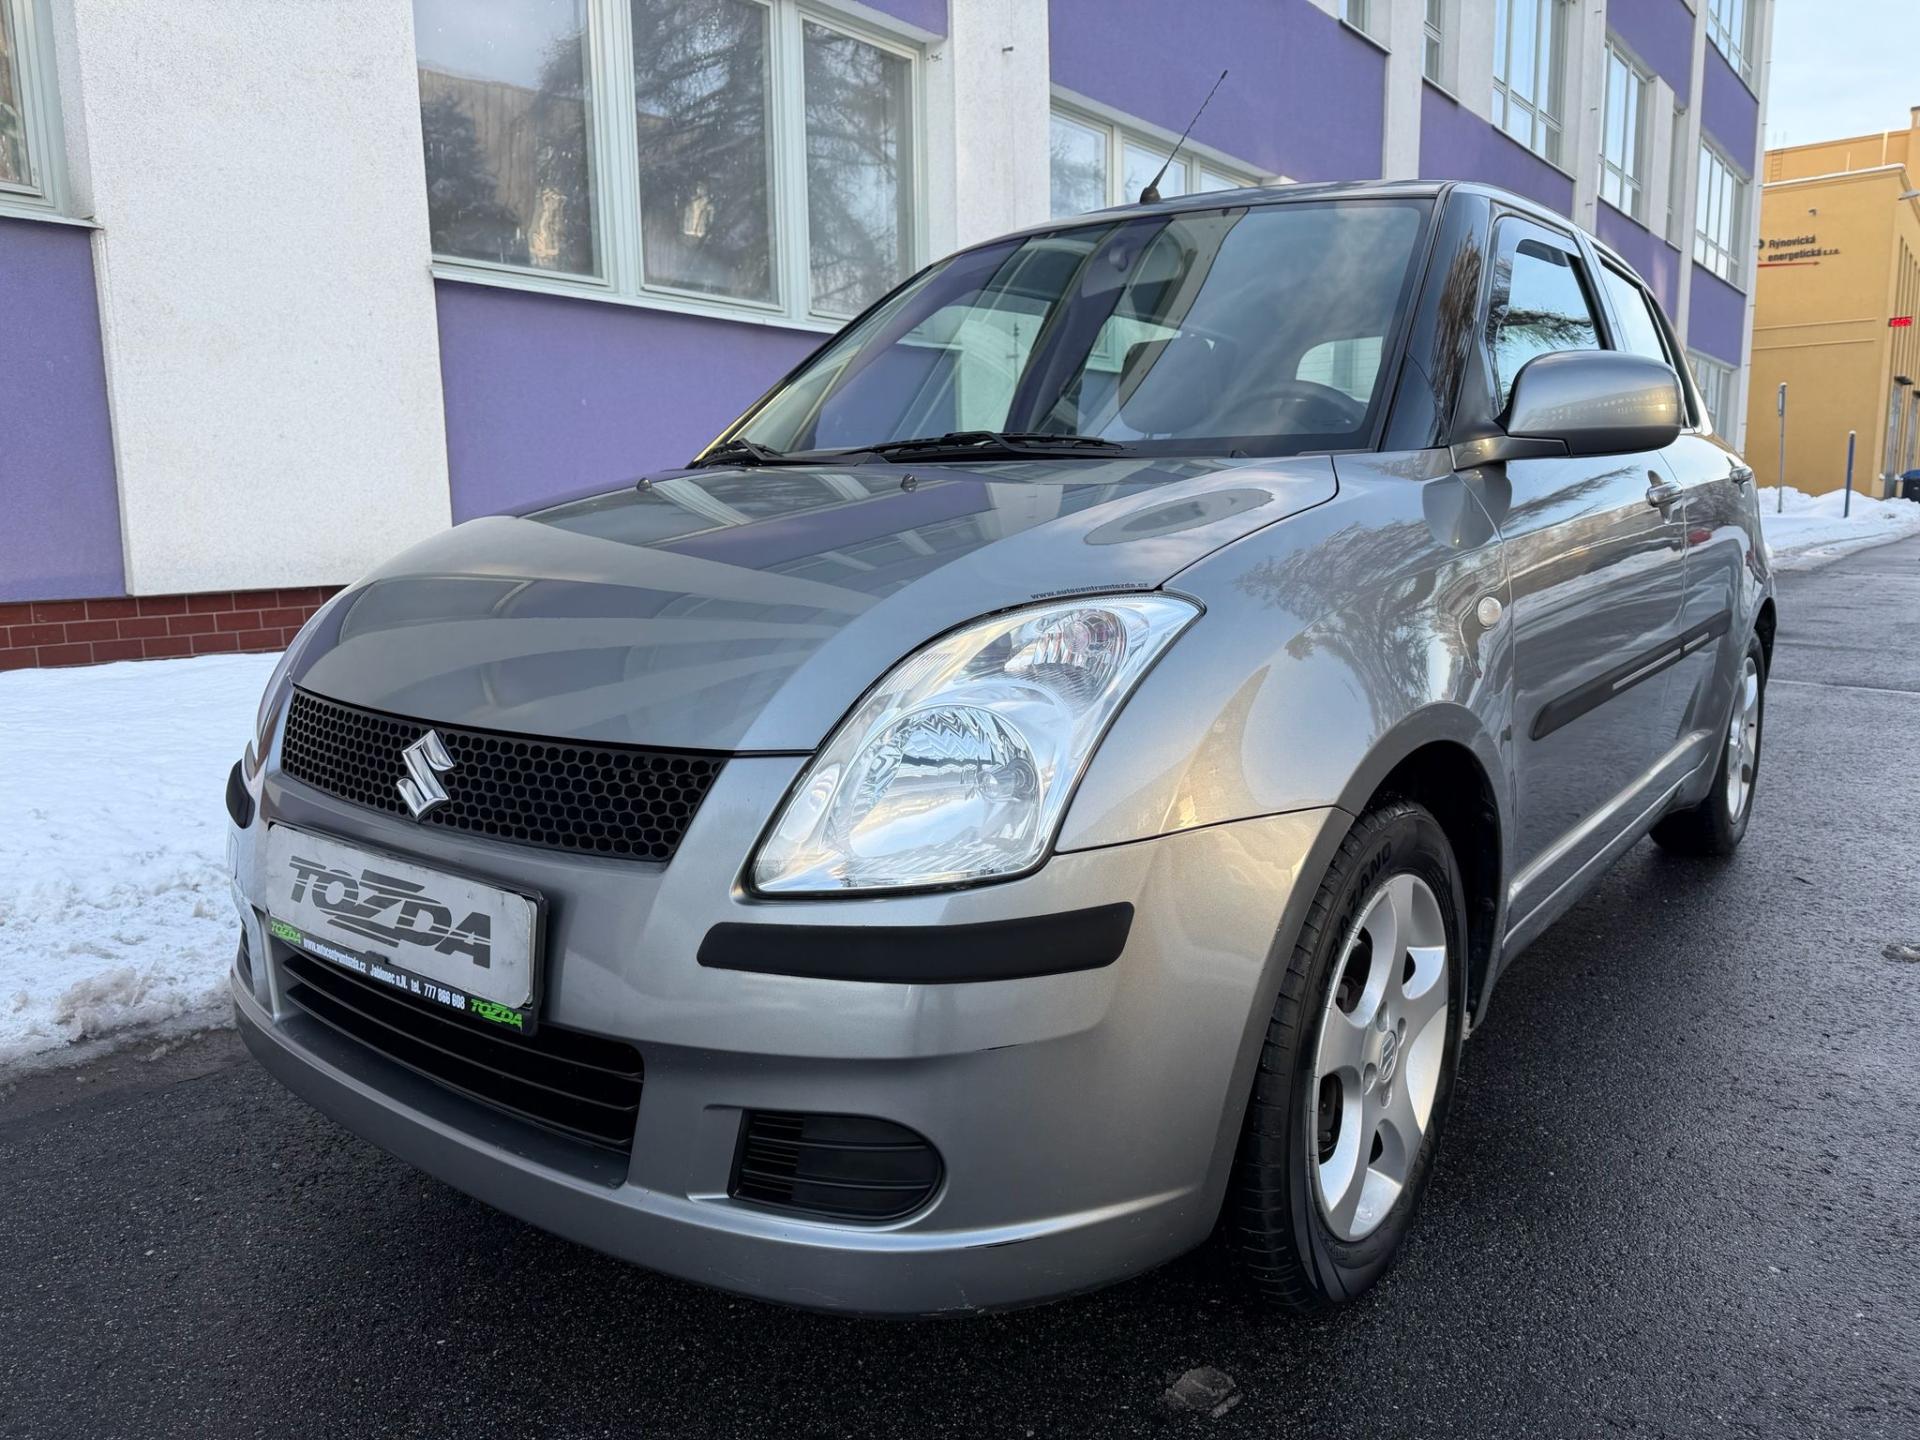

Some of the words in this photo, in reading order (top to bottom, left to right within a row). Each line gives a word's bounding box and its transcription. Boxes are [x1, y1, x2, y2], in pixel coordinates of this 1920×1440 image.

[288, 855, 492, 969] TOZDA
[271, 919, 301, 945] TOZDA
[424, 983, 437, 1000] 777
[470, 998, 523, 1031] TOZDA
